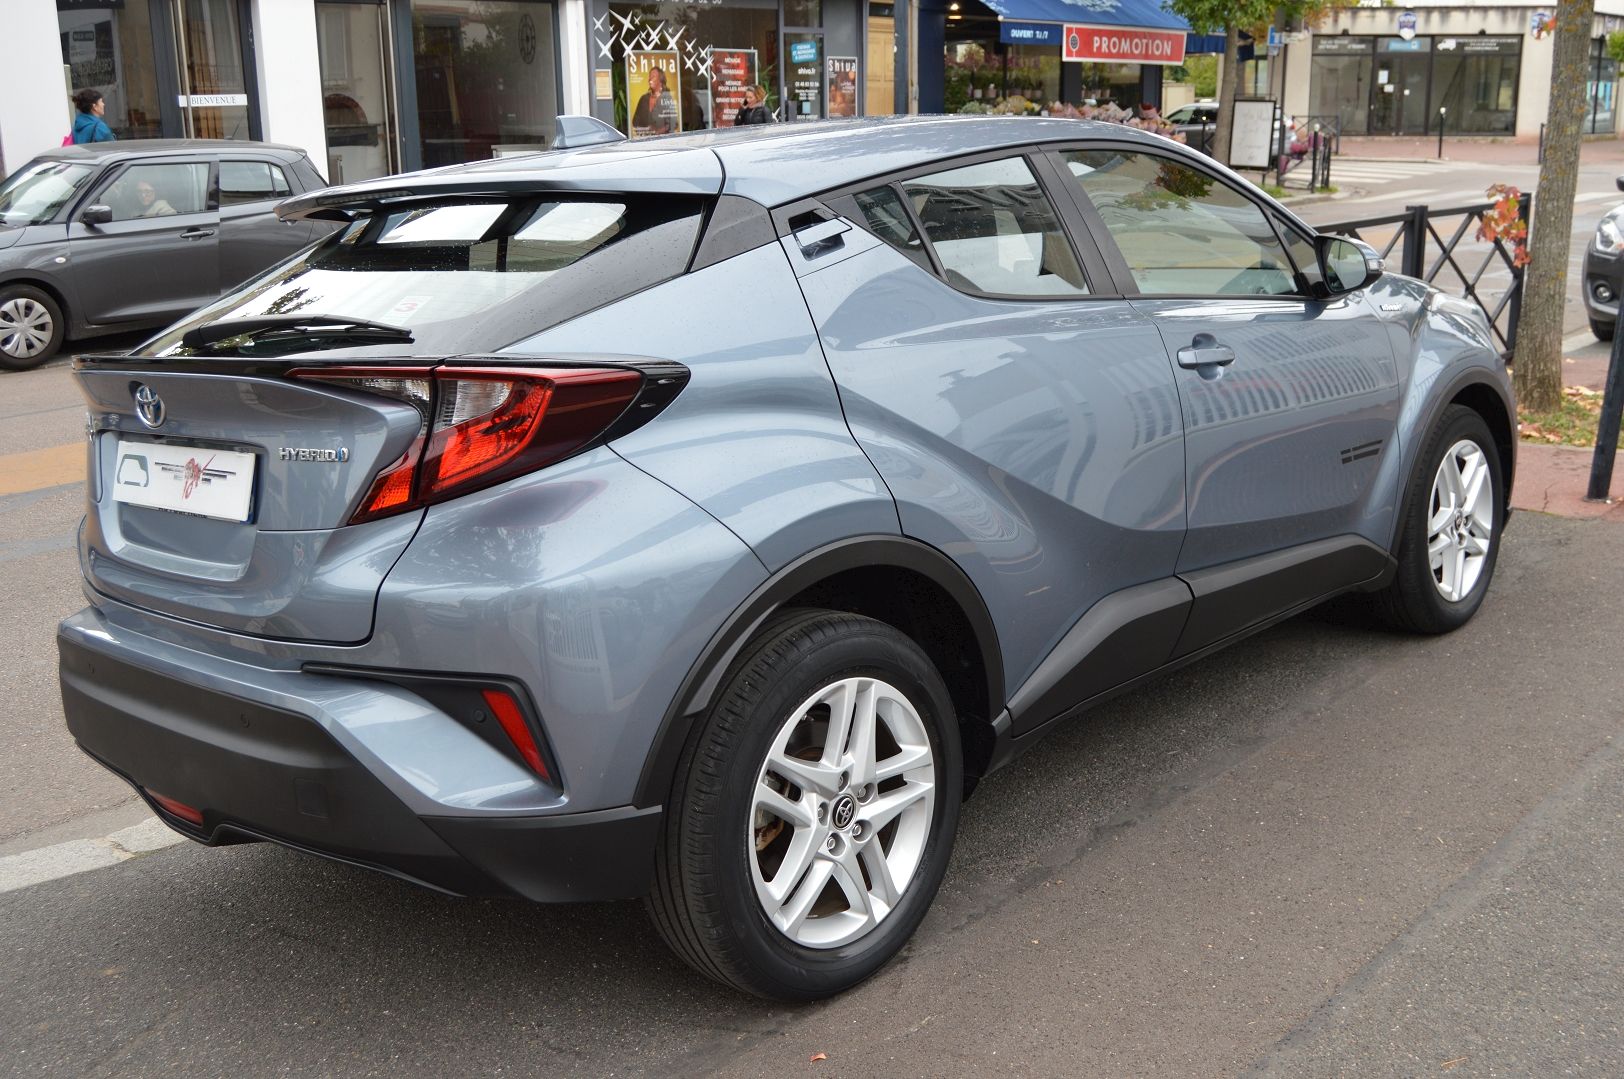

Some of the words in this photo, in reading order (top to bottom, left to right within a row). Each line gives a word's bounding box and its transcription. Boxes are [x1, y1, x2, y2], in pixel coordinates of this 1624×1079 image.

[1093, 36, 1172, 56] PROMOTION
[191, 95, 237, 105] BIENVENUE
[279, 447, 338, 462] HYBRID
